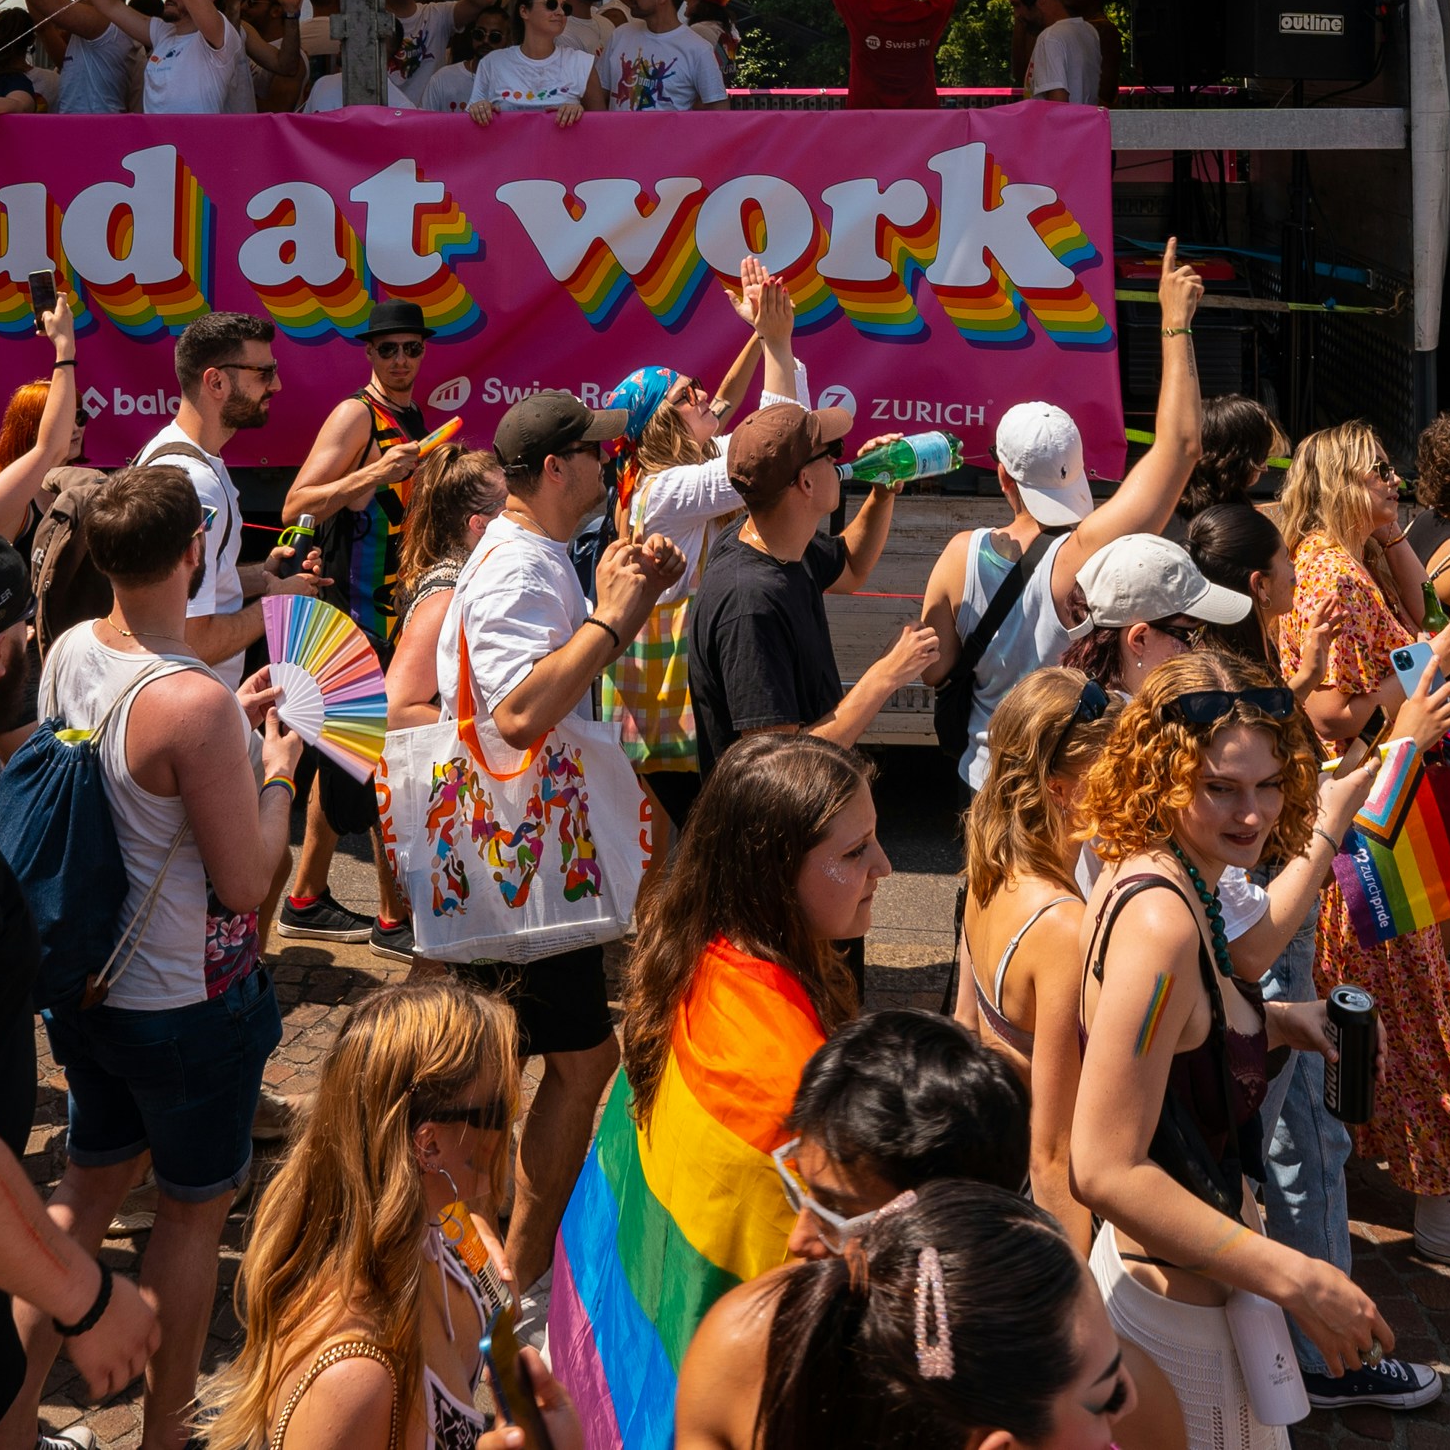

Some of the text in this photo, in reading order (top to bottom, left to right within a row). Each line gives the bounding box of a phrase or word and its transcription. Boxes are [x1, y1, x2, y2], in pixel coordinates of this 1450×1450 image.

[1280, 14, 1342, 32] outline
[885, 40, 917, 49] Swiss
[238, 156, 470, 318] at
[496, 141, 1095, 322] work
[870, 398, 986, 426] ZURICH
[1360, 864, 1391, 929] zurichpride
